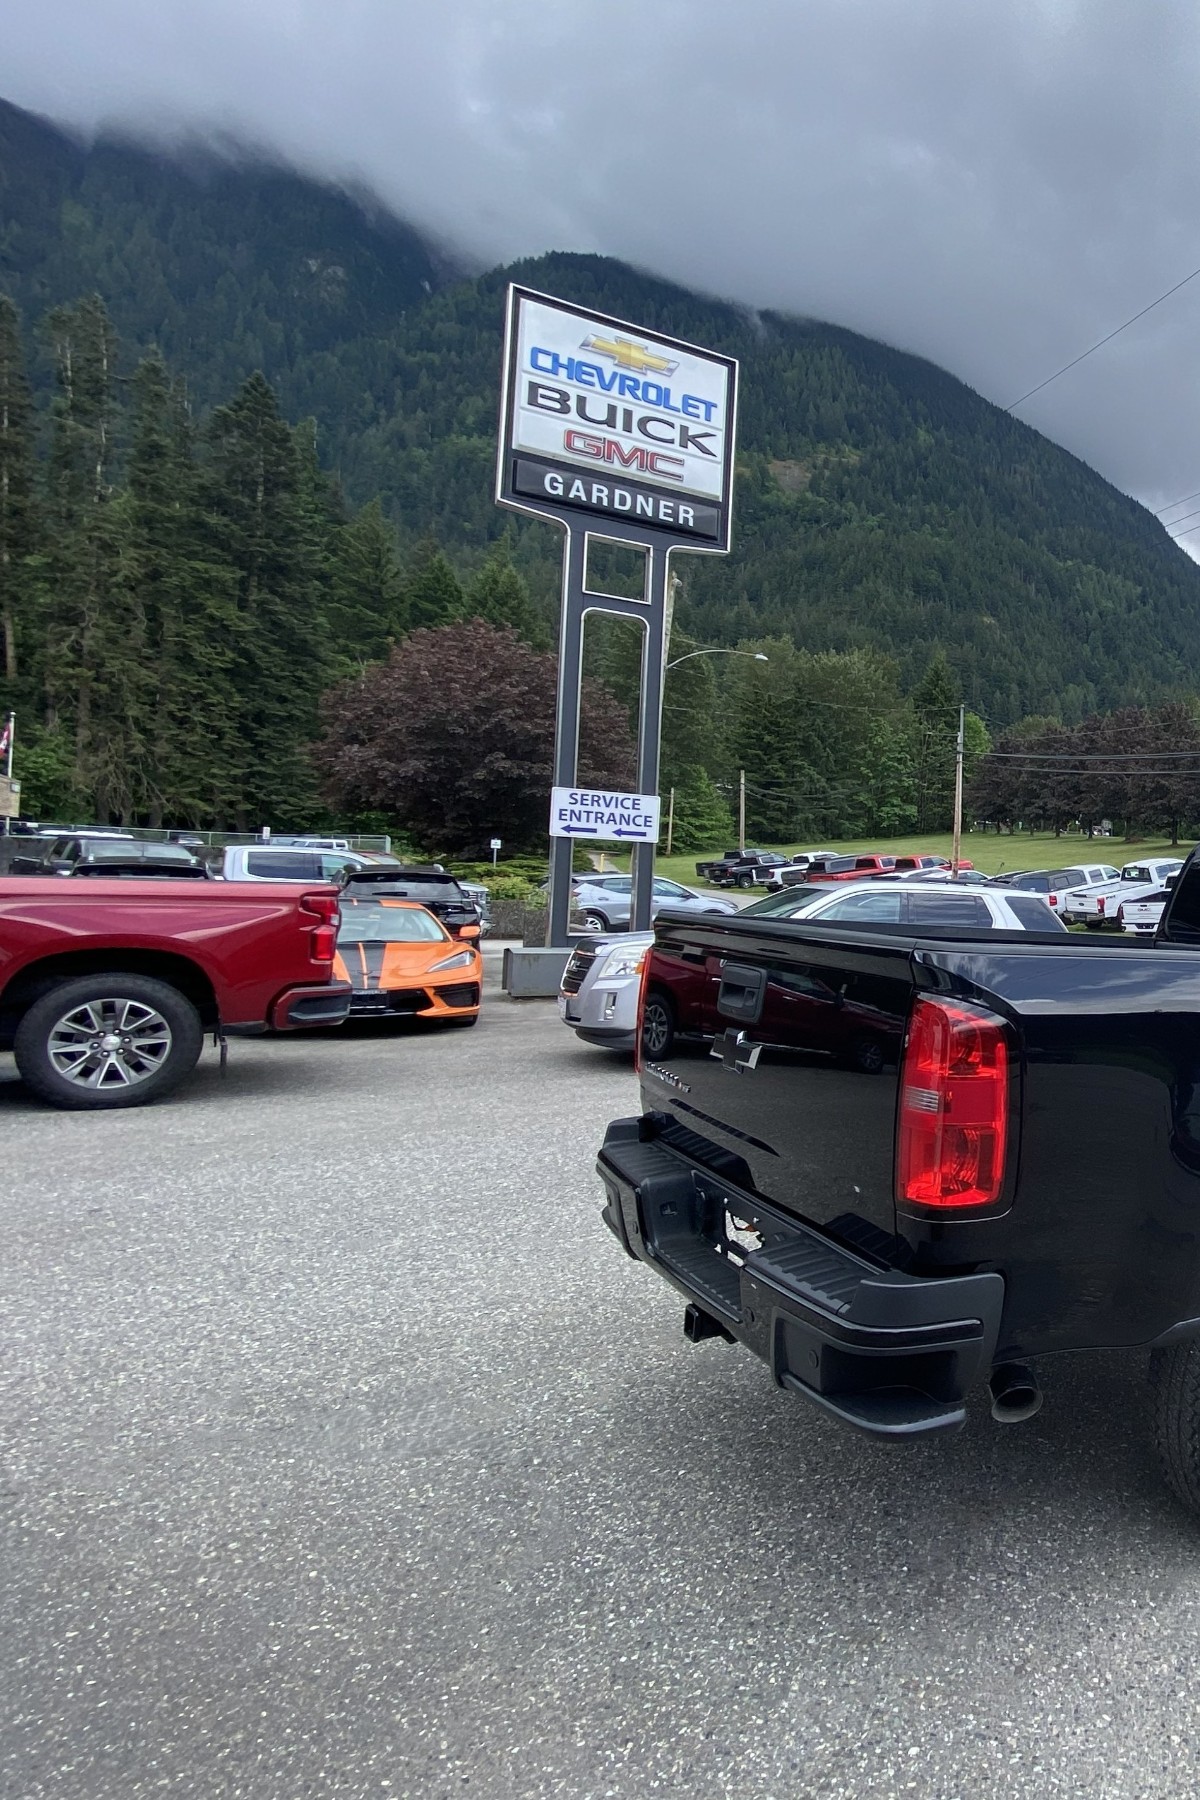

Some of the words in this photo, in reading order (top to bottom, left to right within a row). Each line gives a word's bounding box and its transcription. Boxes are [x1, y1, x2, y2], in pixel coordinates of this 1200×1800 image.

[530, 346, 718, 421] CHEVROLET
[527, 380, 717, 457] BUICK
[563, 429, 685, 481] GMC
[543, 473, 695, 527] GARDNER
[558, 809, 653, 827] ENTRANCE
[569, 792, 641, 810] SERVICE
